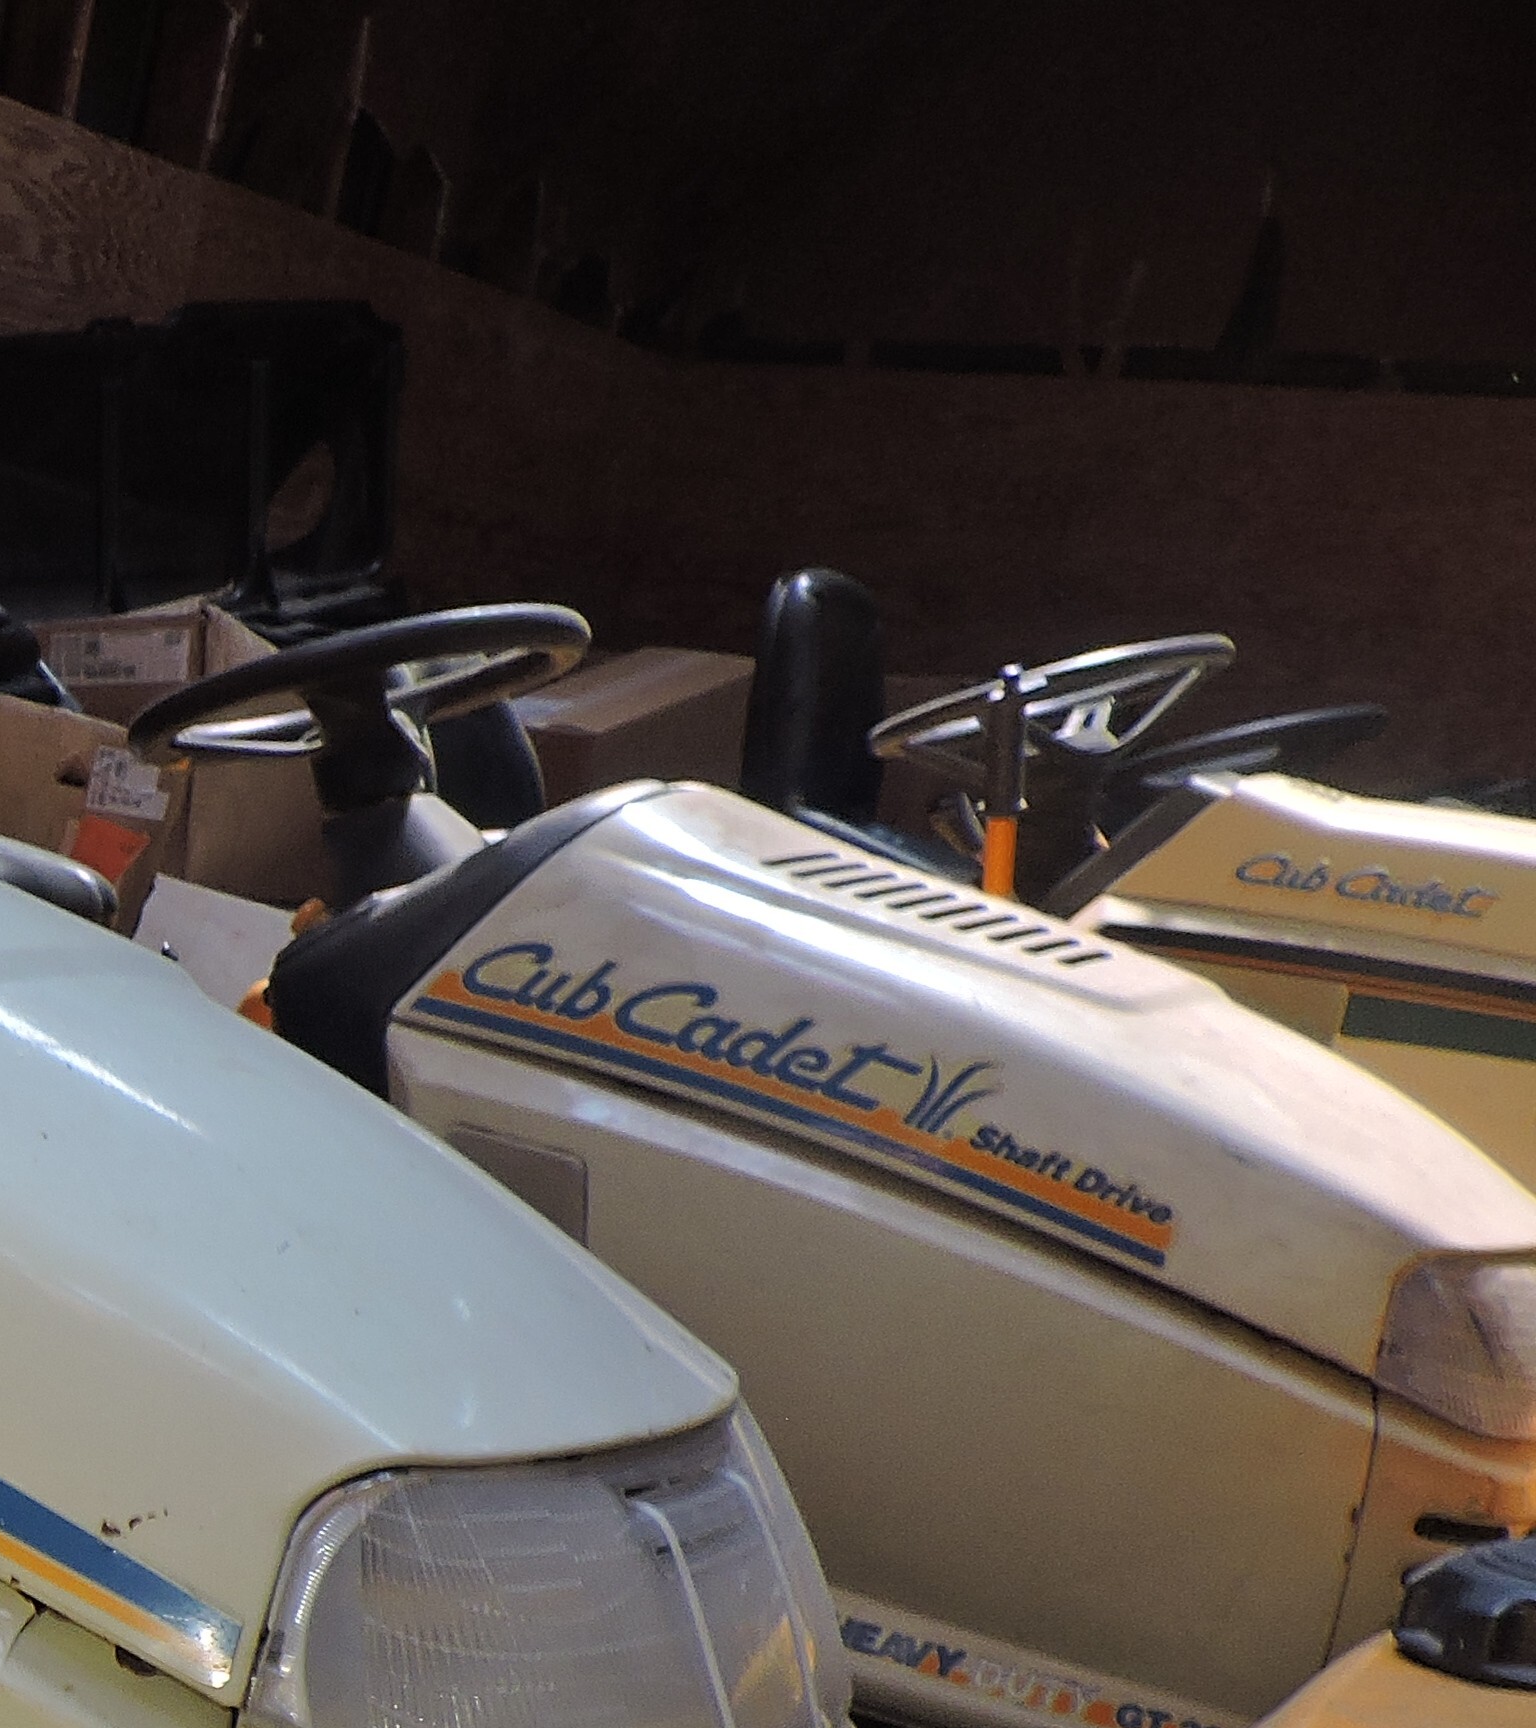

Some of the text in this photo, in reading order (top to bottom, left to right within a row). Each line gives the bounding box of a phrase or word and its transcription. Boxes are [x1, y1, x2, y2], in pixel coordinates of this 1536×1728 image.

[1236, 853, 1499, 917] Cub Cadet
[460, 941, 1175, 1225] Cub Cadet Shaft Drive
